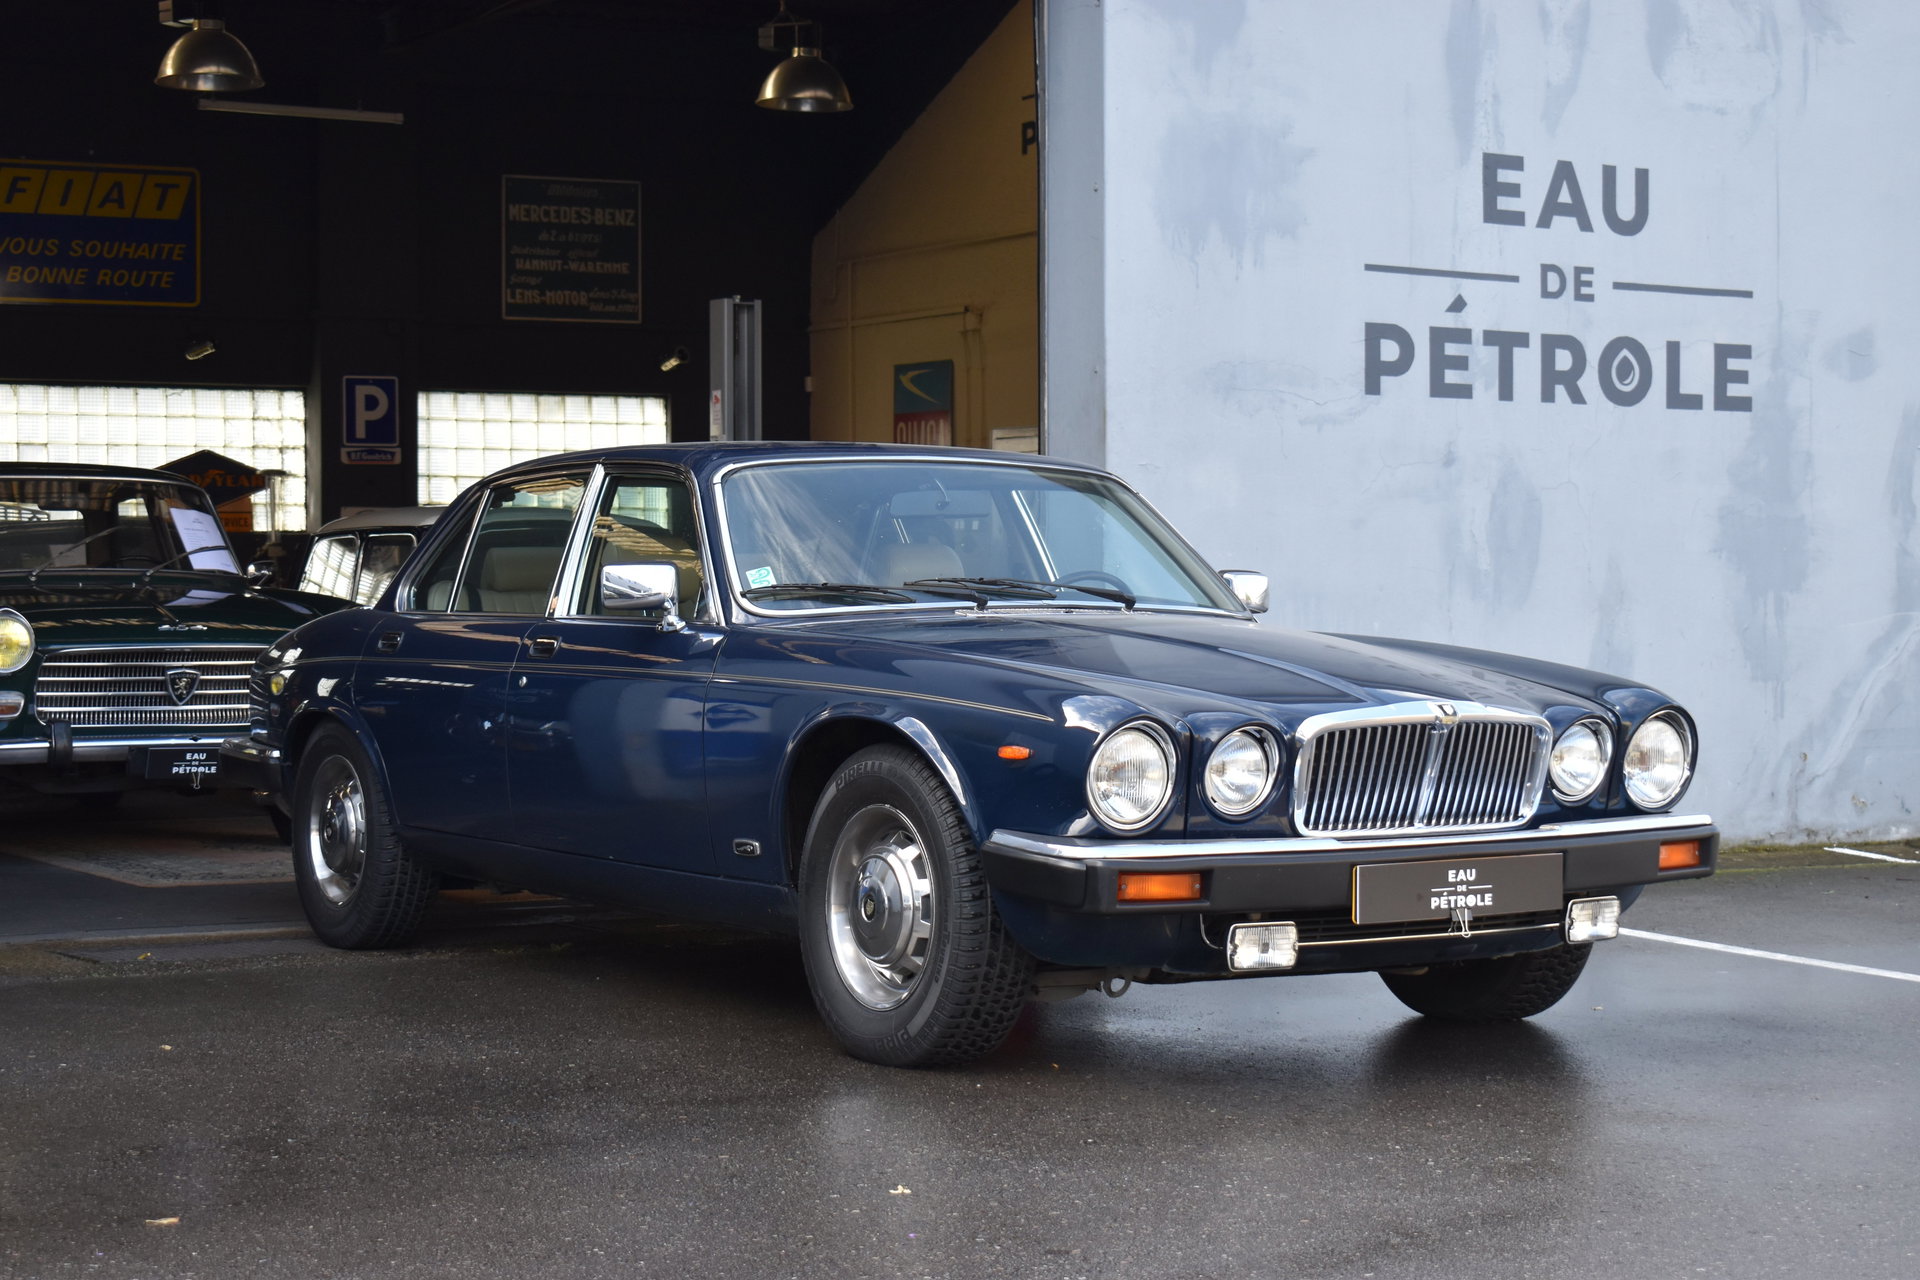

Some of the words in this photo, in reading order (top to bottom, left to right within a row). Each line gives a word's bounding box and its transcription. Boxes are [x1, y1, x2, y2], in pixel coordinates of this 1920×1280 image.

[4, 175, 180, 212] FIAT
[1482, 152, 1649, 236] EAU
[69, 239, 187, 261] SOUHAITE
[6, 265, 89, 285] BONNE
[97, 268, 176, 288] ROUTE
[1540, 263, 1595, 302] DE
[1364, 293, 1753, 413] PÉTROLE
[355, 384, 389, 439] P
[186, 752, 207, 760] EAU
[834, 760, 884, 794] PIRELLI
[1448, 868, 1476, 882] EAU
[1456, 884, 1468, 892] DE
[1430, 892, 1493, 909] PÉTROLE
